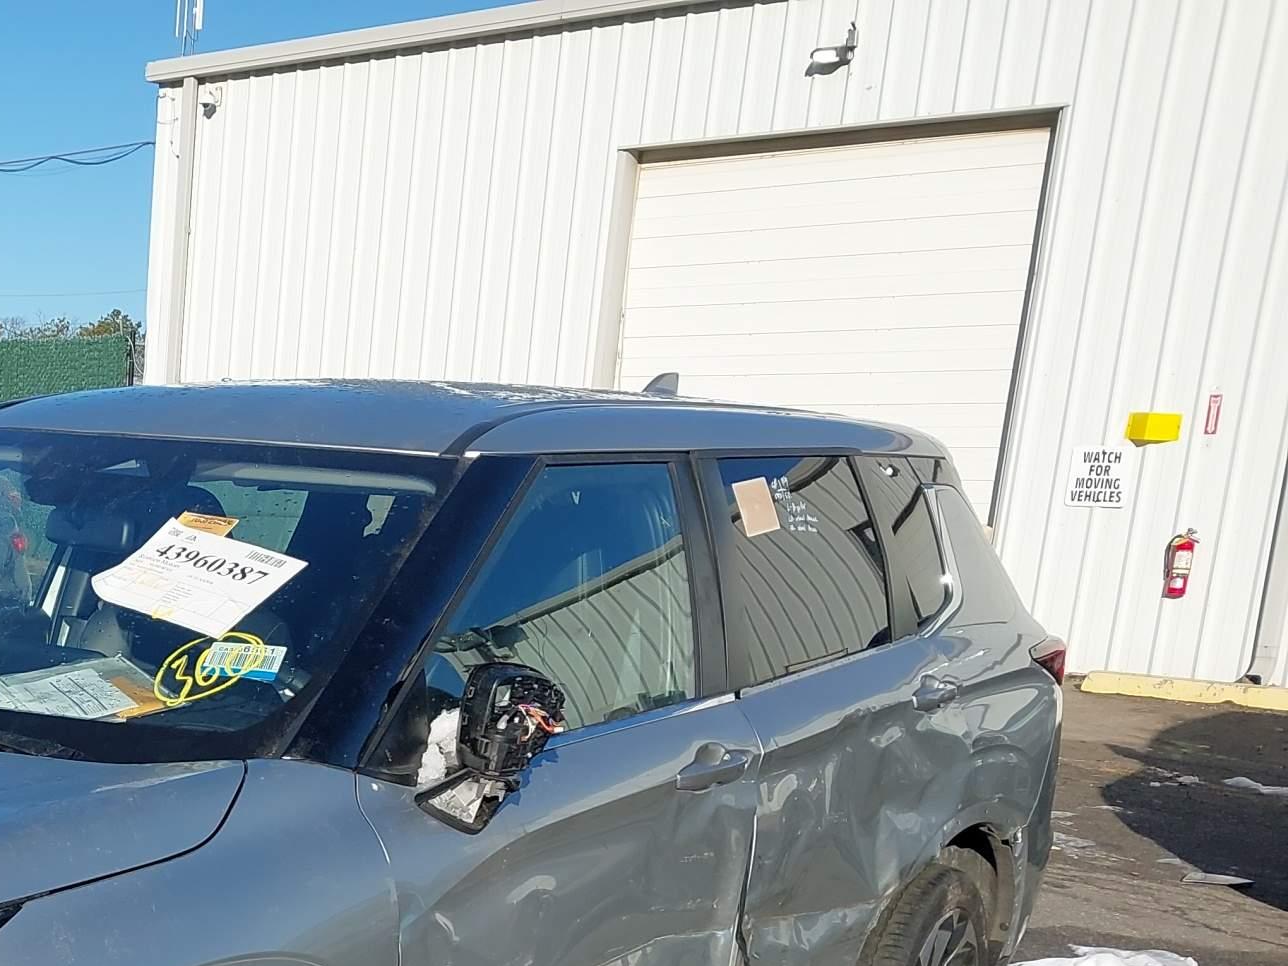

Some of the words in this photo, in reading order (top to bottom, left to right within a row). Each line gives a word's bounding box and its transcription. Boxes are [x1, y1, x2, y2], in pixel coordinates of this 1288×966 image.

[1083, 450, 1122, 464] WATCH
[1088, 464, 1111, 477] FOR
[1075, 477, 1120, 490] MOVING
[1070, 490, 1123, 503] VEHICLES
[155, 543, 270, 586] 43960387
